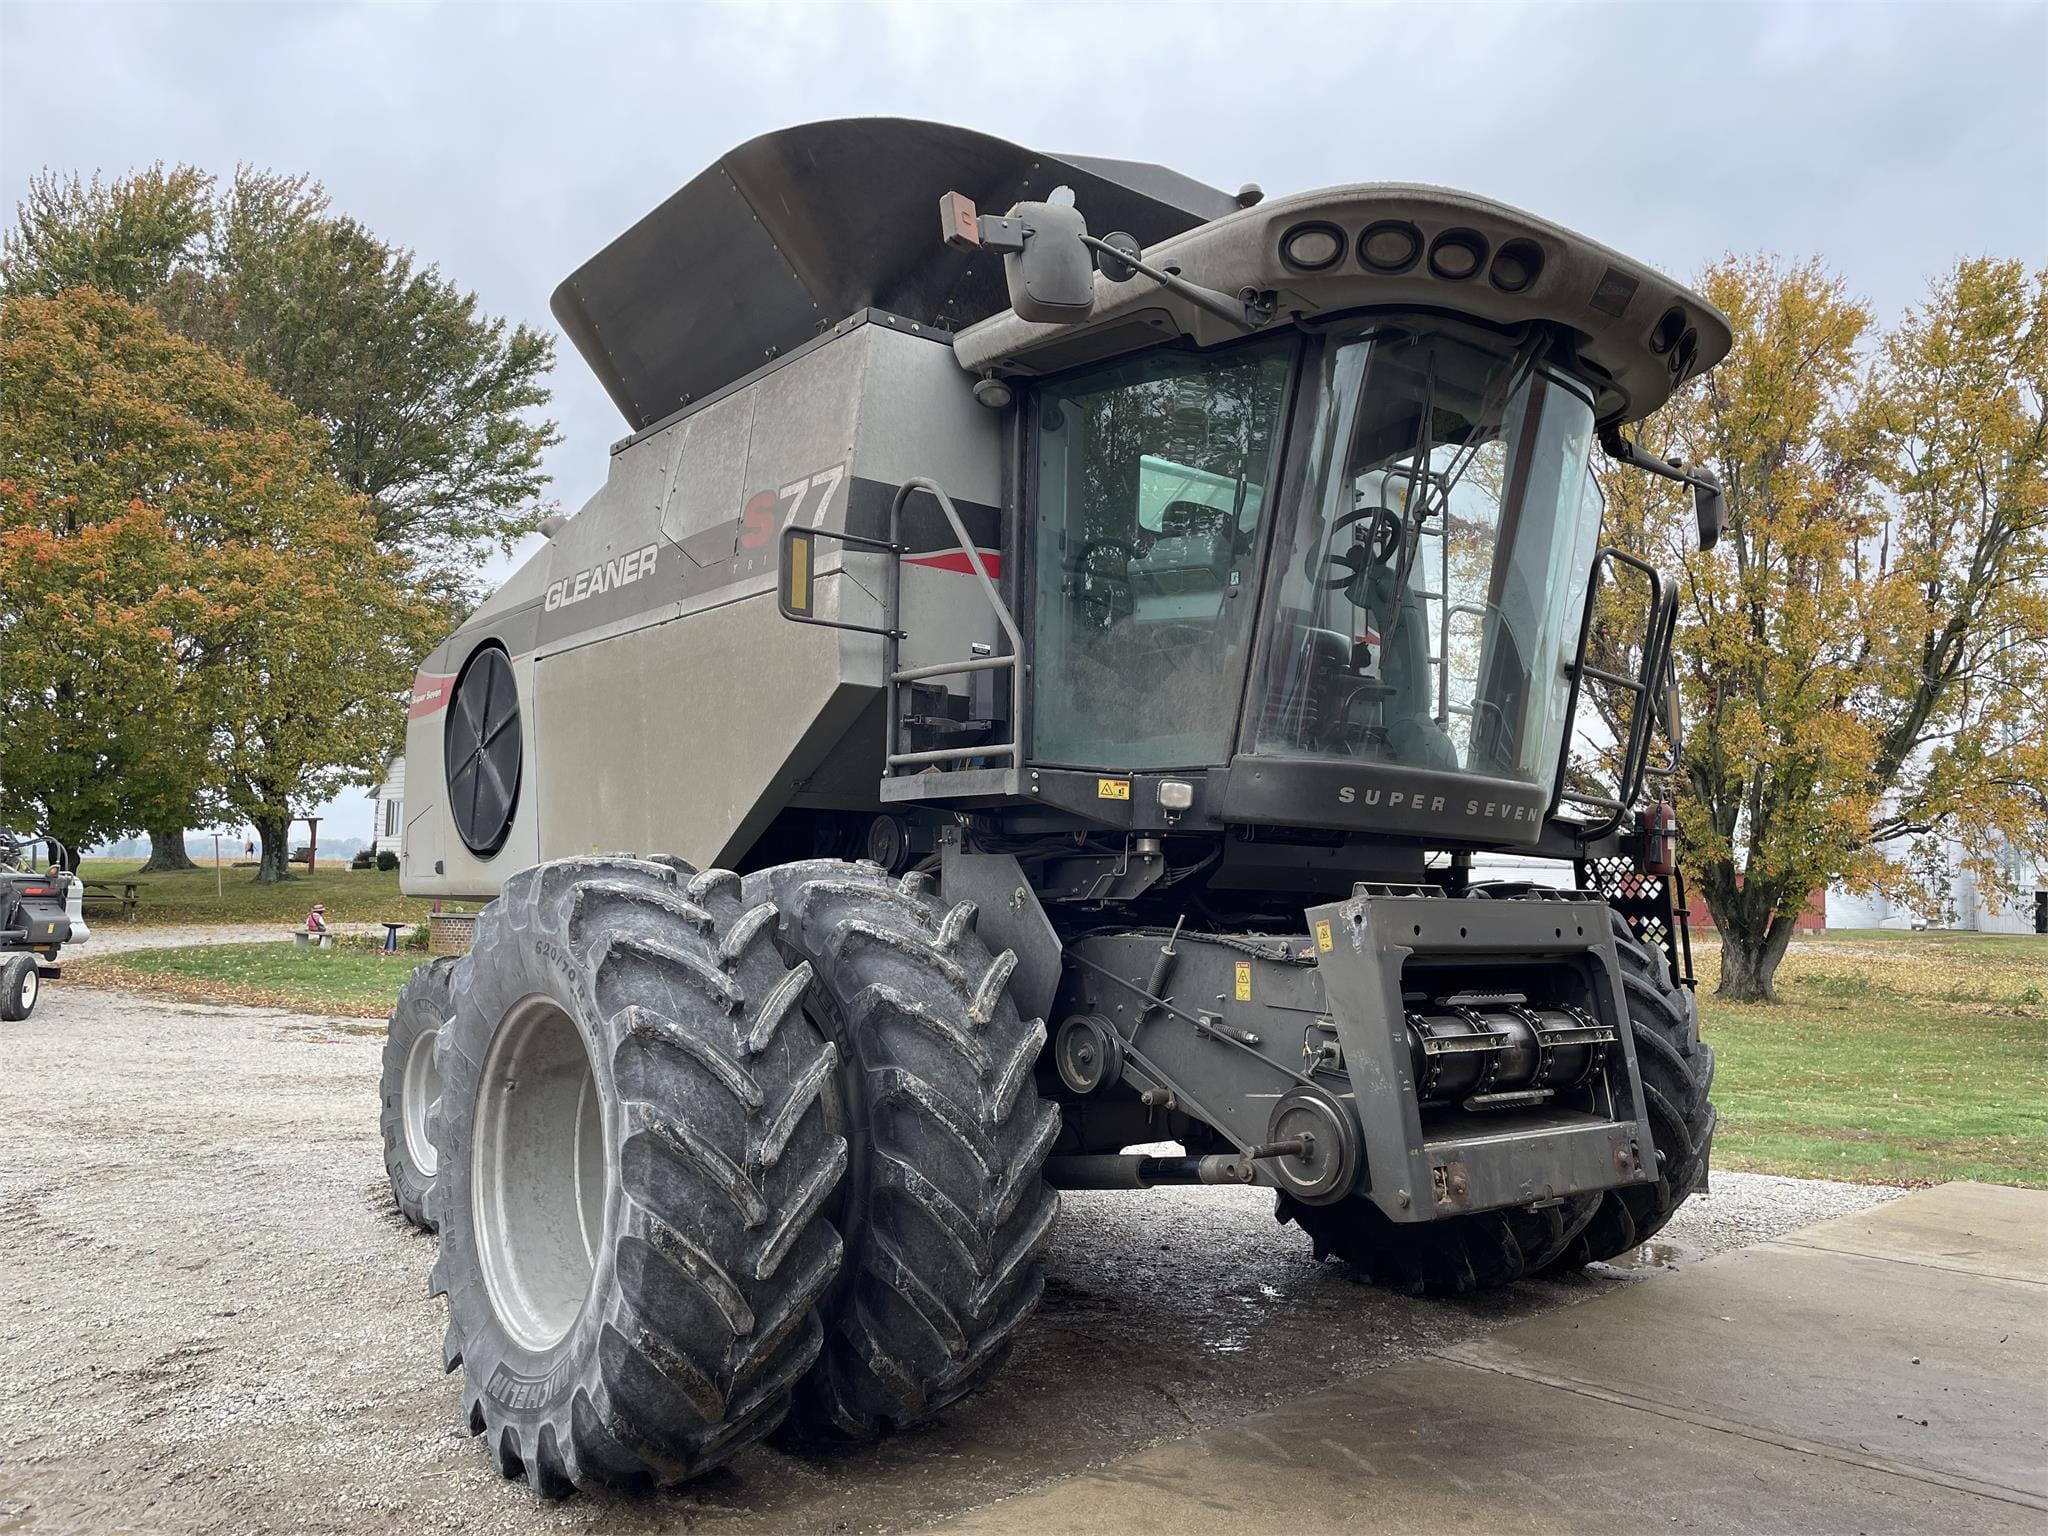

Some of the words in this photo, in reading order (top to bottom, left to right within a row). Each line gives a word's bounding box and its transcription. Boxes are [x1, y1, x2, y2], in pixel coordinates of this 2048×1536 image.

[741, 464, 845, 549] S77
[544, 545, 659, 612] GLEANER
[1338, 786, 1446, 812] SUPER
[1466, 800, 1538, 822] SEVEN
[535, 940, 576, 981] 620/70
[487, 1359, 570, 1409] MICHELIN
